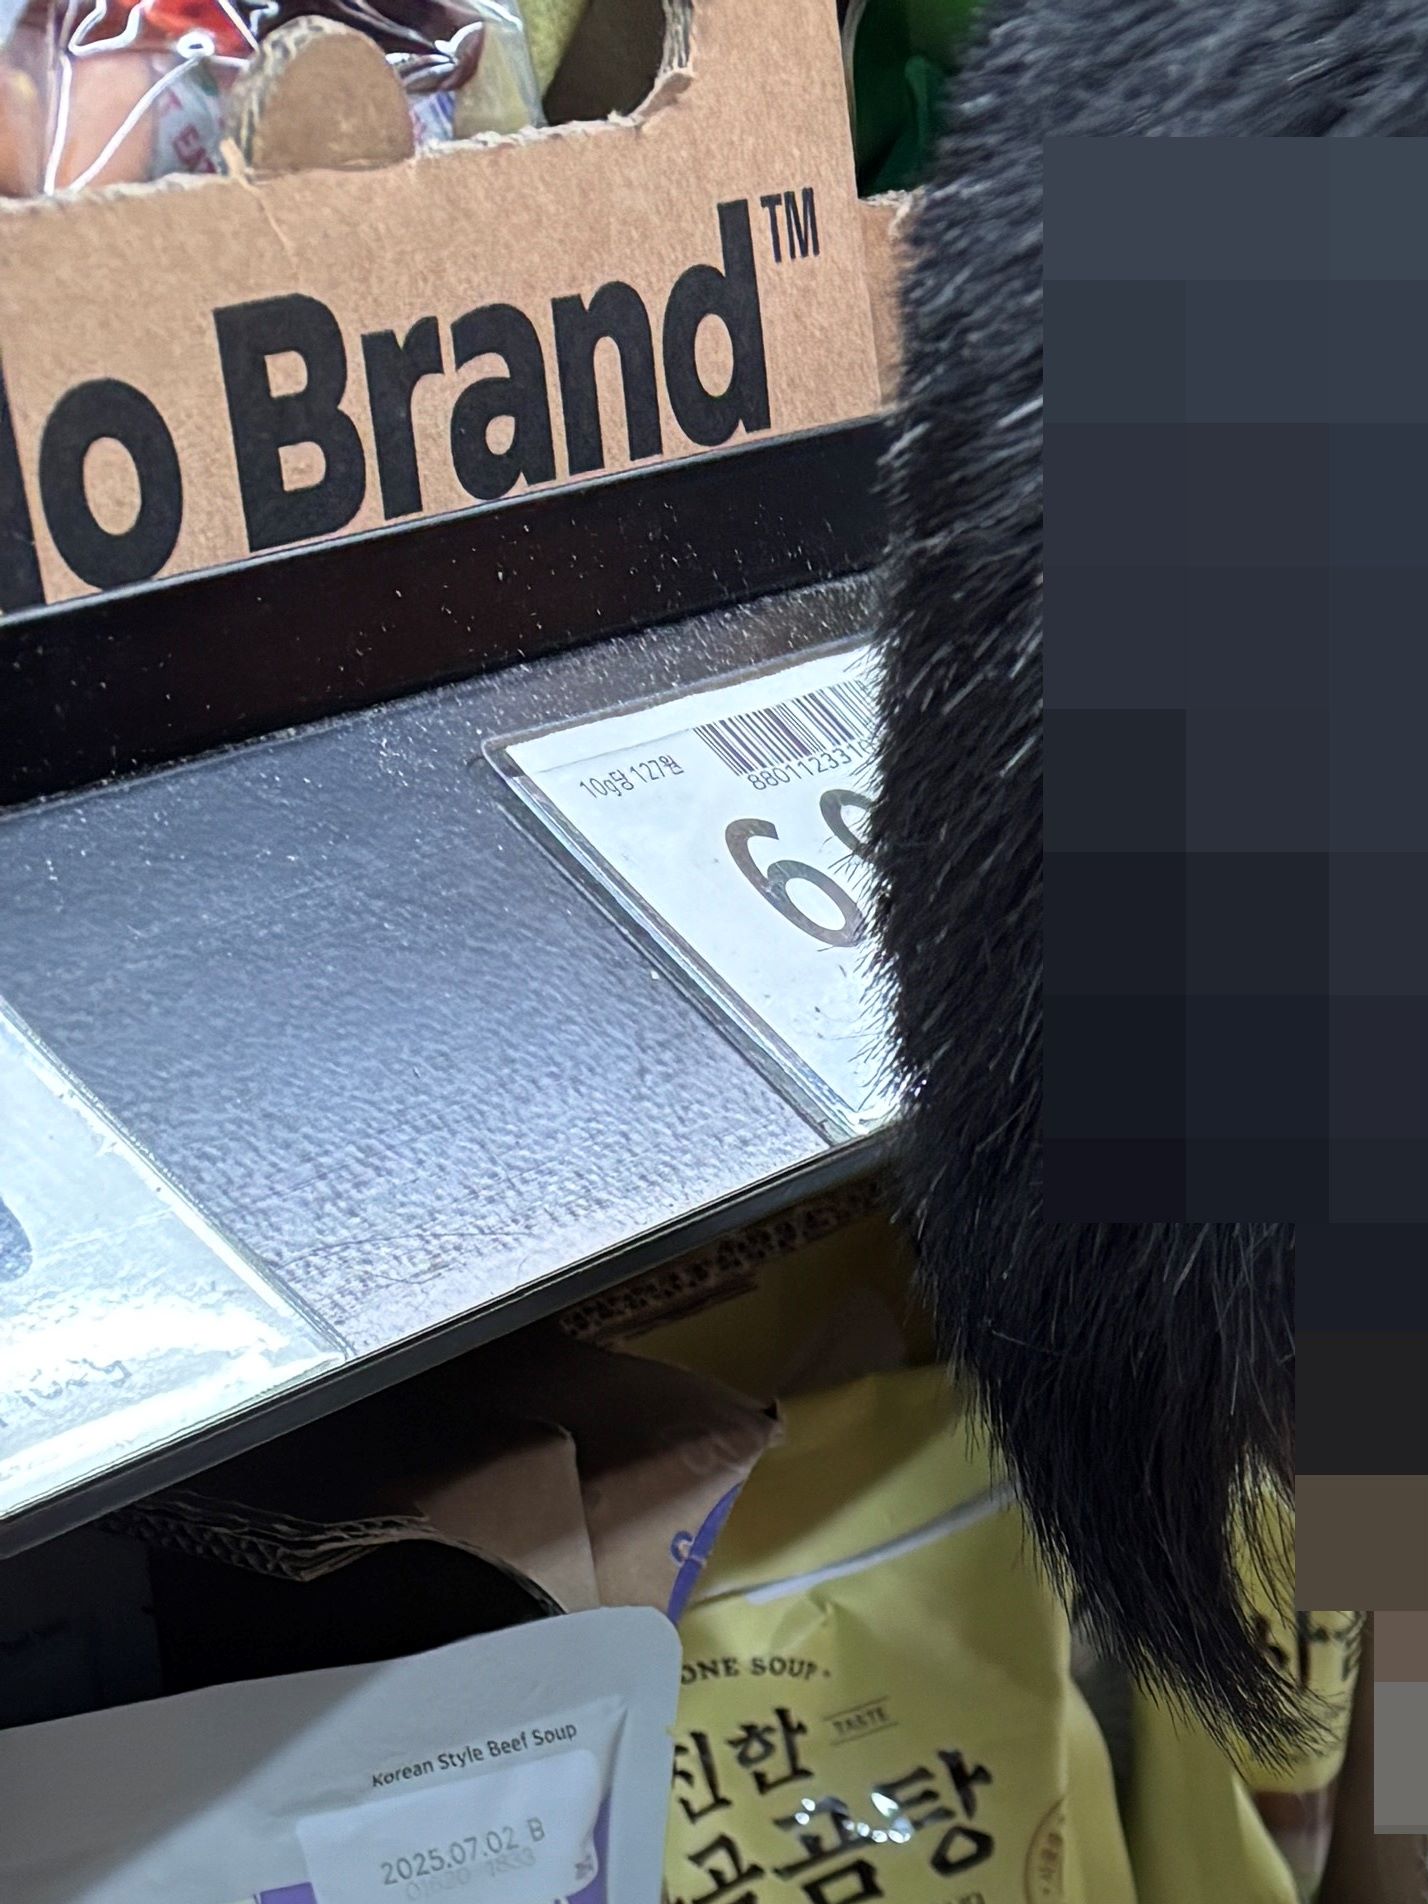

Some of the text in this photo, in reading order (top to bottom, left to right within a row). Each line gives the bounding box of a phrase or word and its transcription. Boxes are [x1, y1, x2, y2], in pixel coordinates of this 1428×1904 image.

[0, 345, 184, 606] o
[629, 754, 684, 785] 127원
[750, 1656, 818, 1681] SOUP
[372, 1724, 578, 1788] Korean Style Beef Soup
[380, 1826, 519, 1886] 2025.07.02
[526, 1817, 547, 1843] B
